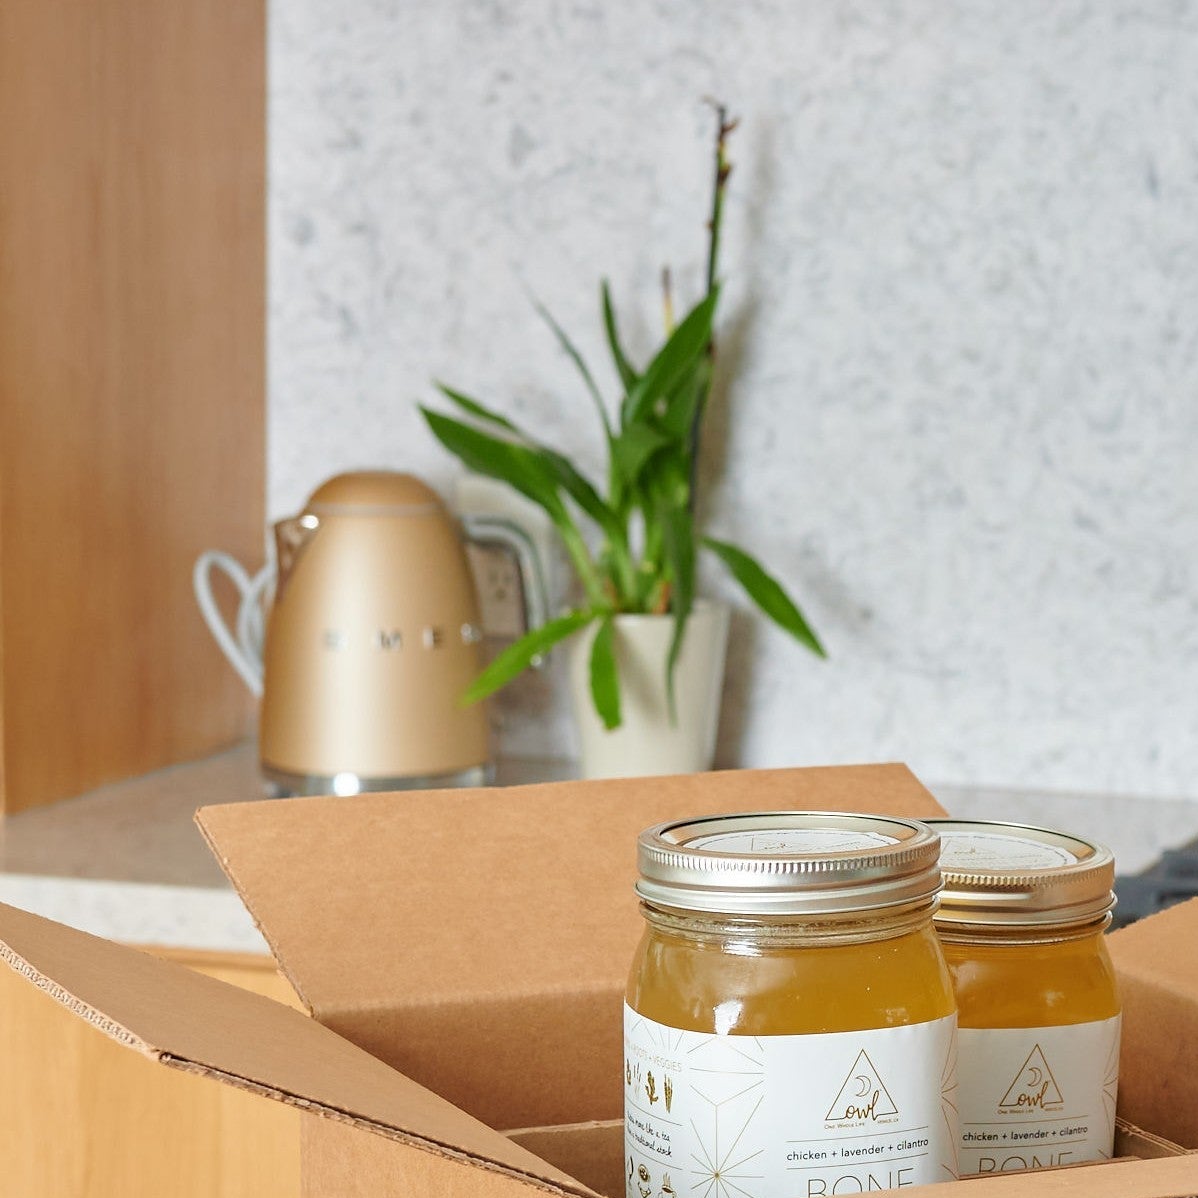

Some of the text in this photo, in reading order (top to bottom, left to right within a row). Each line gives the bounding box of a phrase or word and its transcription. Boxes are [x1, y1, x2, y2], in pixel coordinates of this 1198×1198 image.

[845, 1090, 880, 1121] owl
[1018, 1081, 1049, 1109] owl
[962, 1132, 999, 1142] chicken
[1011, 1129, 1049, 1140] lavender
[1059, 1126, 1089, 1137] cilantro
[786, 1150, 827, 1161] chicken
[841, 1145, 885, 1158] lavender
[896, 1138, 929, 1152] cilantro
